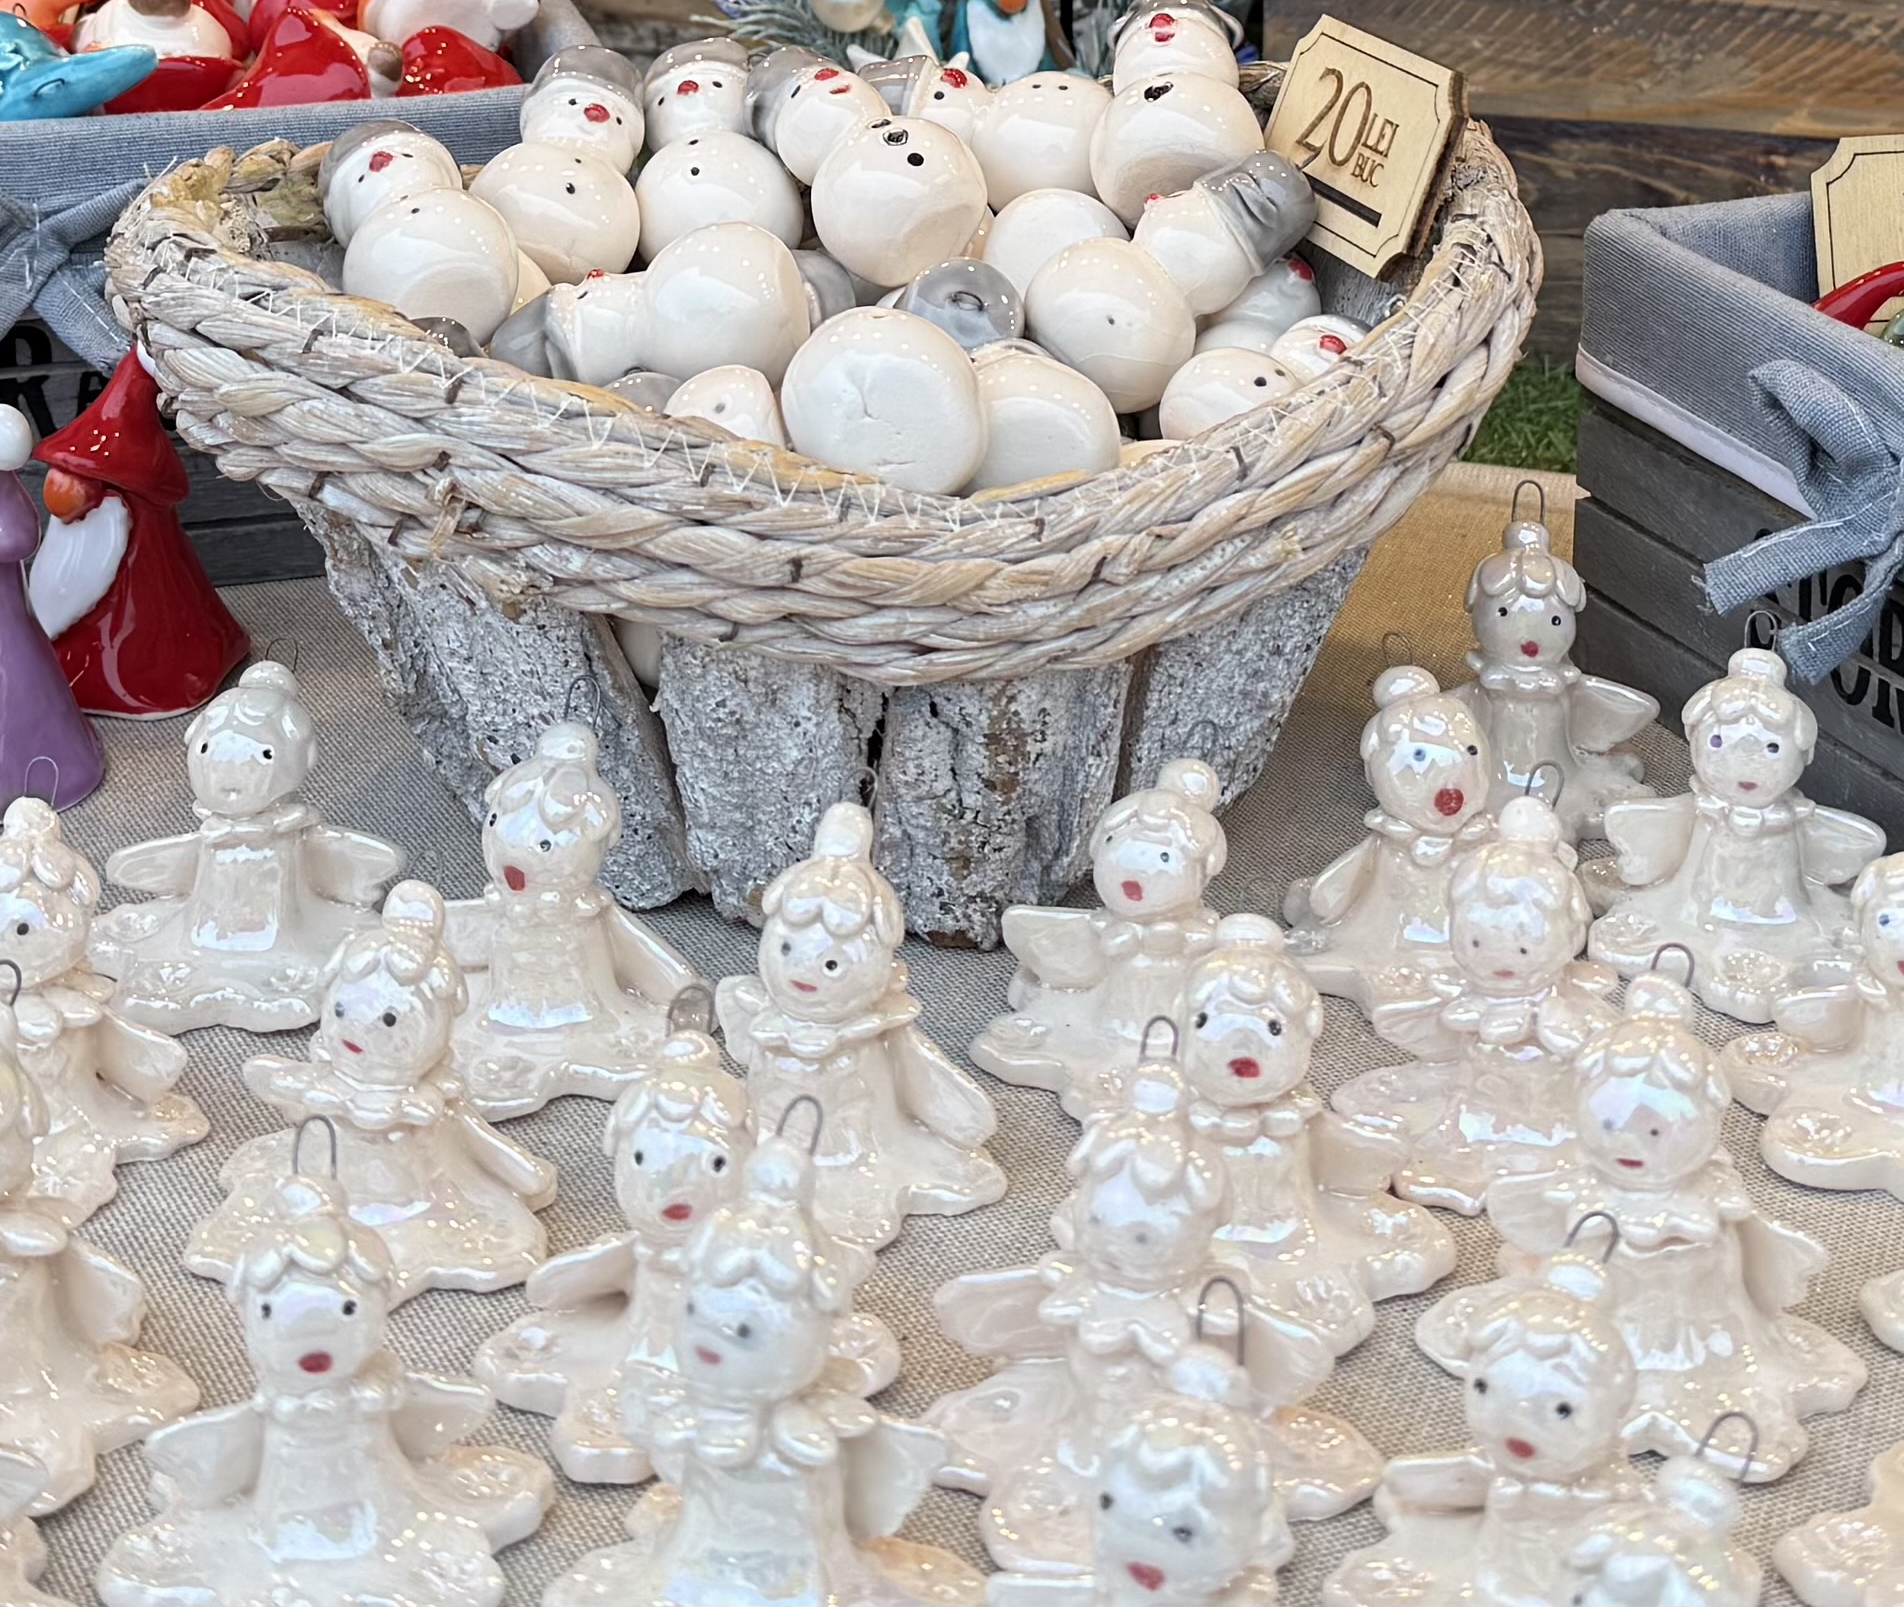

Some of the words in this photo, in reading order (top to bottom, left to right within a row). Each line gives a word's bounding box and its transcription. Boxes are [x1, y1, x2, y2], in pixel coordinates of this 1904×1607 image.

[1295, 66, 1373, 168] 20
[1360, 112, 1400, 158] LEI
[1350, 152, 1385, 188] BUC
